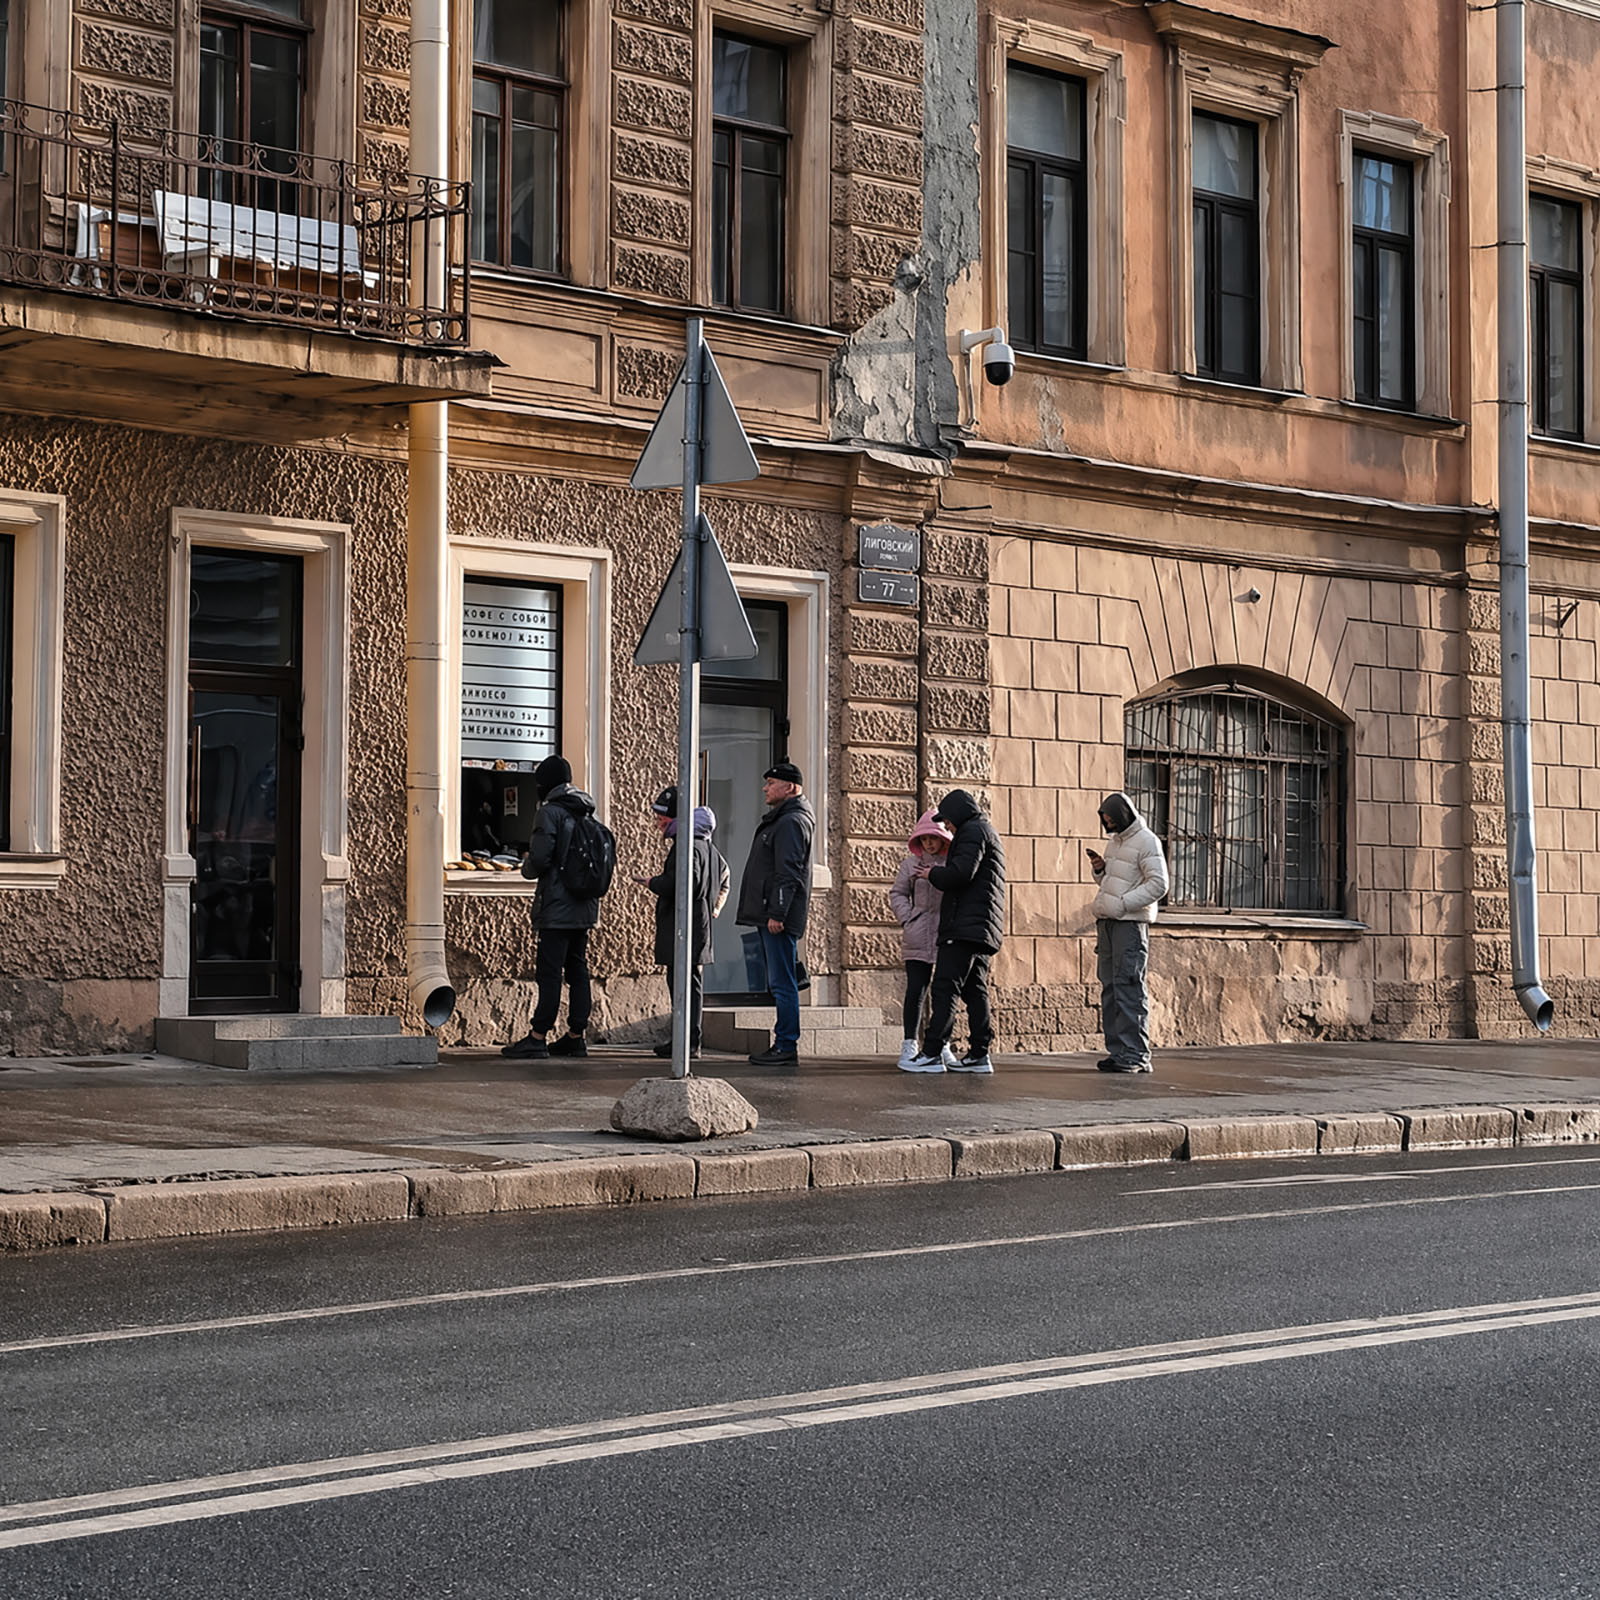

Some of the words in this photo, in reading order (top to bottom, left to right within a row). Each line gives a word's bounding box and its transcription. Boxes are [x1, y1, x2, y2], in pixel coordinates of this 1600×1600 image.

[864, 537, 914, 553] ЛИГОВСКИЙ
[882, 582, 895, 597] 77
[463, 608, 492, 620] КОФЕ
[499, 611, 505, 621] С
[512, 613, 546, 624] СОБОЙ
[461, 725, 522, 737] АМЕРИКАНО
